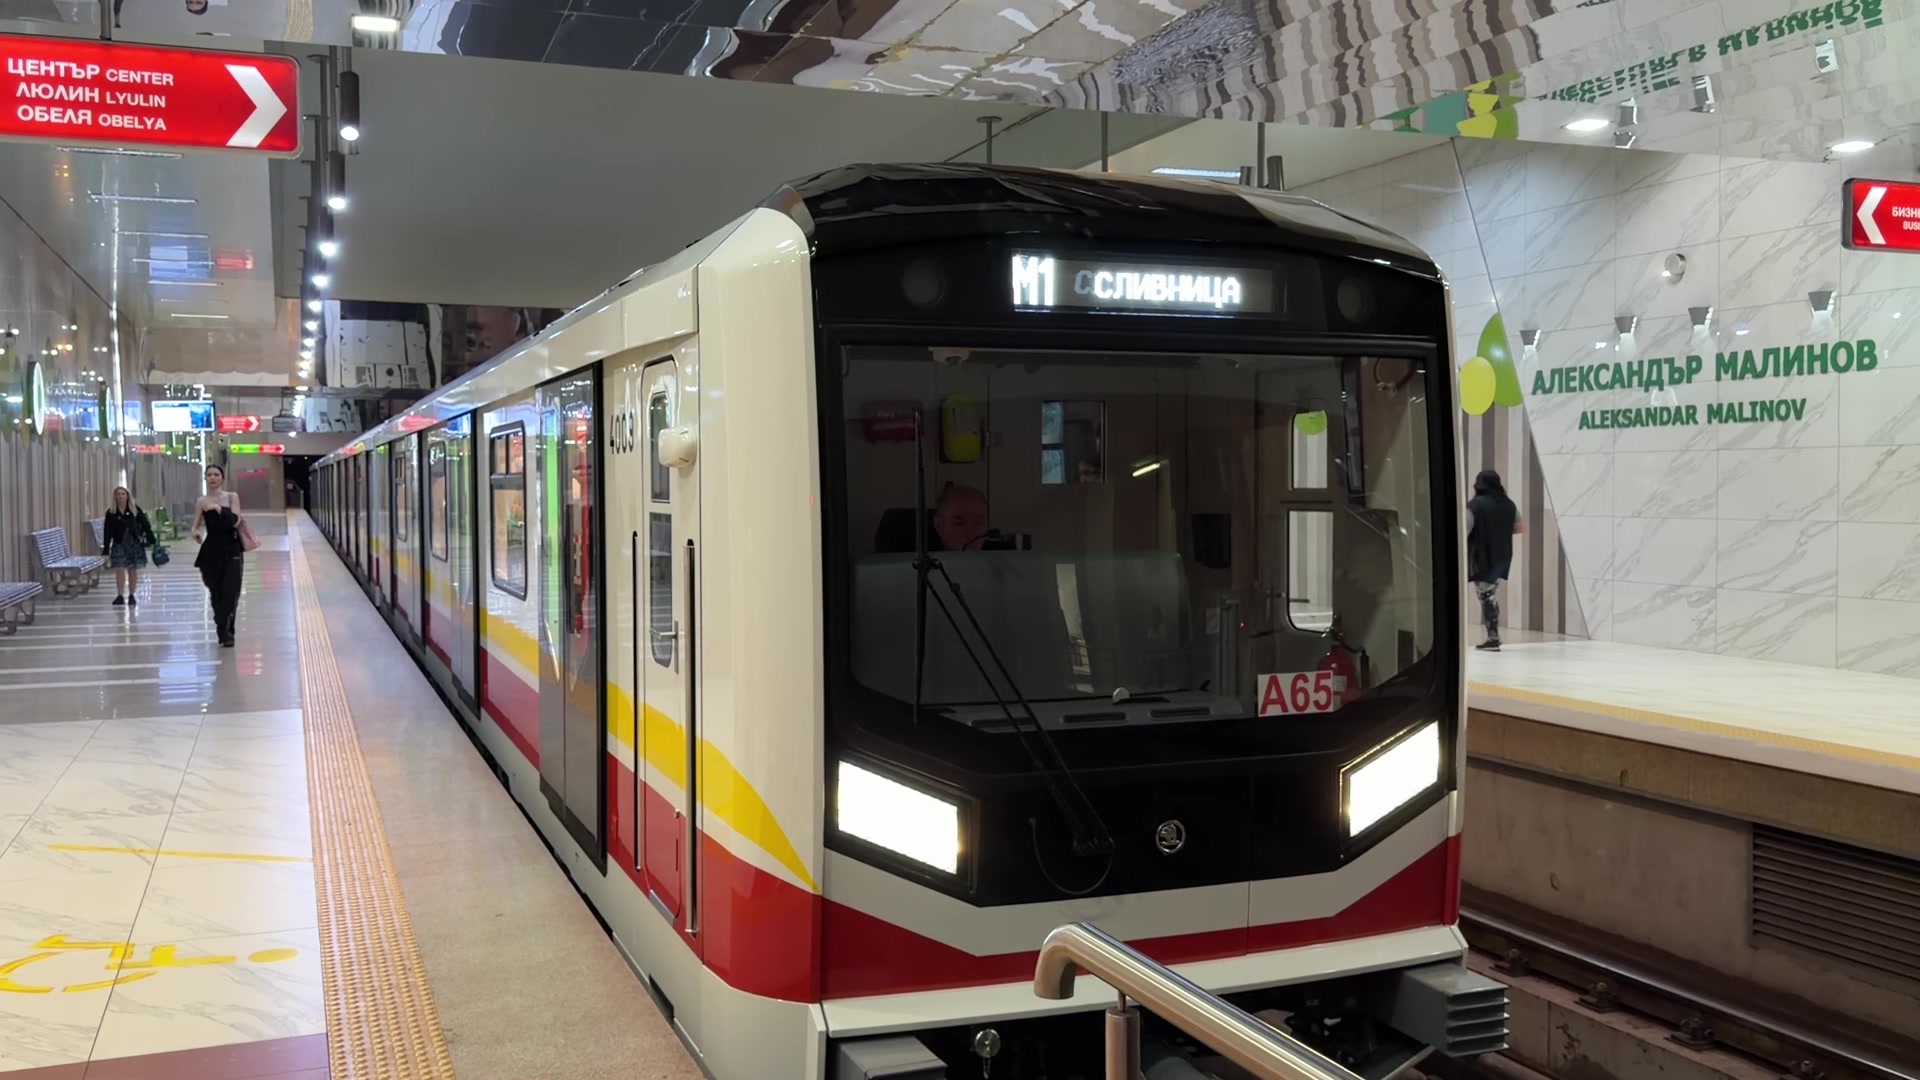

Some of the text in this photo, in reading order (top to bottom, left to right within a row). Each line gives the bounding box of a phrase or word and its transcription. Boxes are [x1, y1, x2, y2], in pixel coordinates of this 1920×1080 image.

[7, 57, 174, 86] ЦЕНТЪР CENTER
[16, 82, 166, 108] ЛЮЛИН LYULIN
[17, 105, 167, 131] ОБЕЛЯ OBELYA
[1531, 339, 1878, 395] АЛЕКСАНДЪР МАЛИНОВ
[1578, 398, 1807, 431] ALEKSANDAR MALINOV
[1259, 672, 1332, 715] A65
